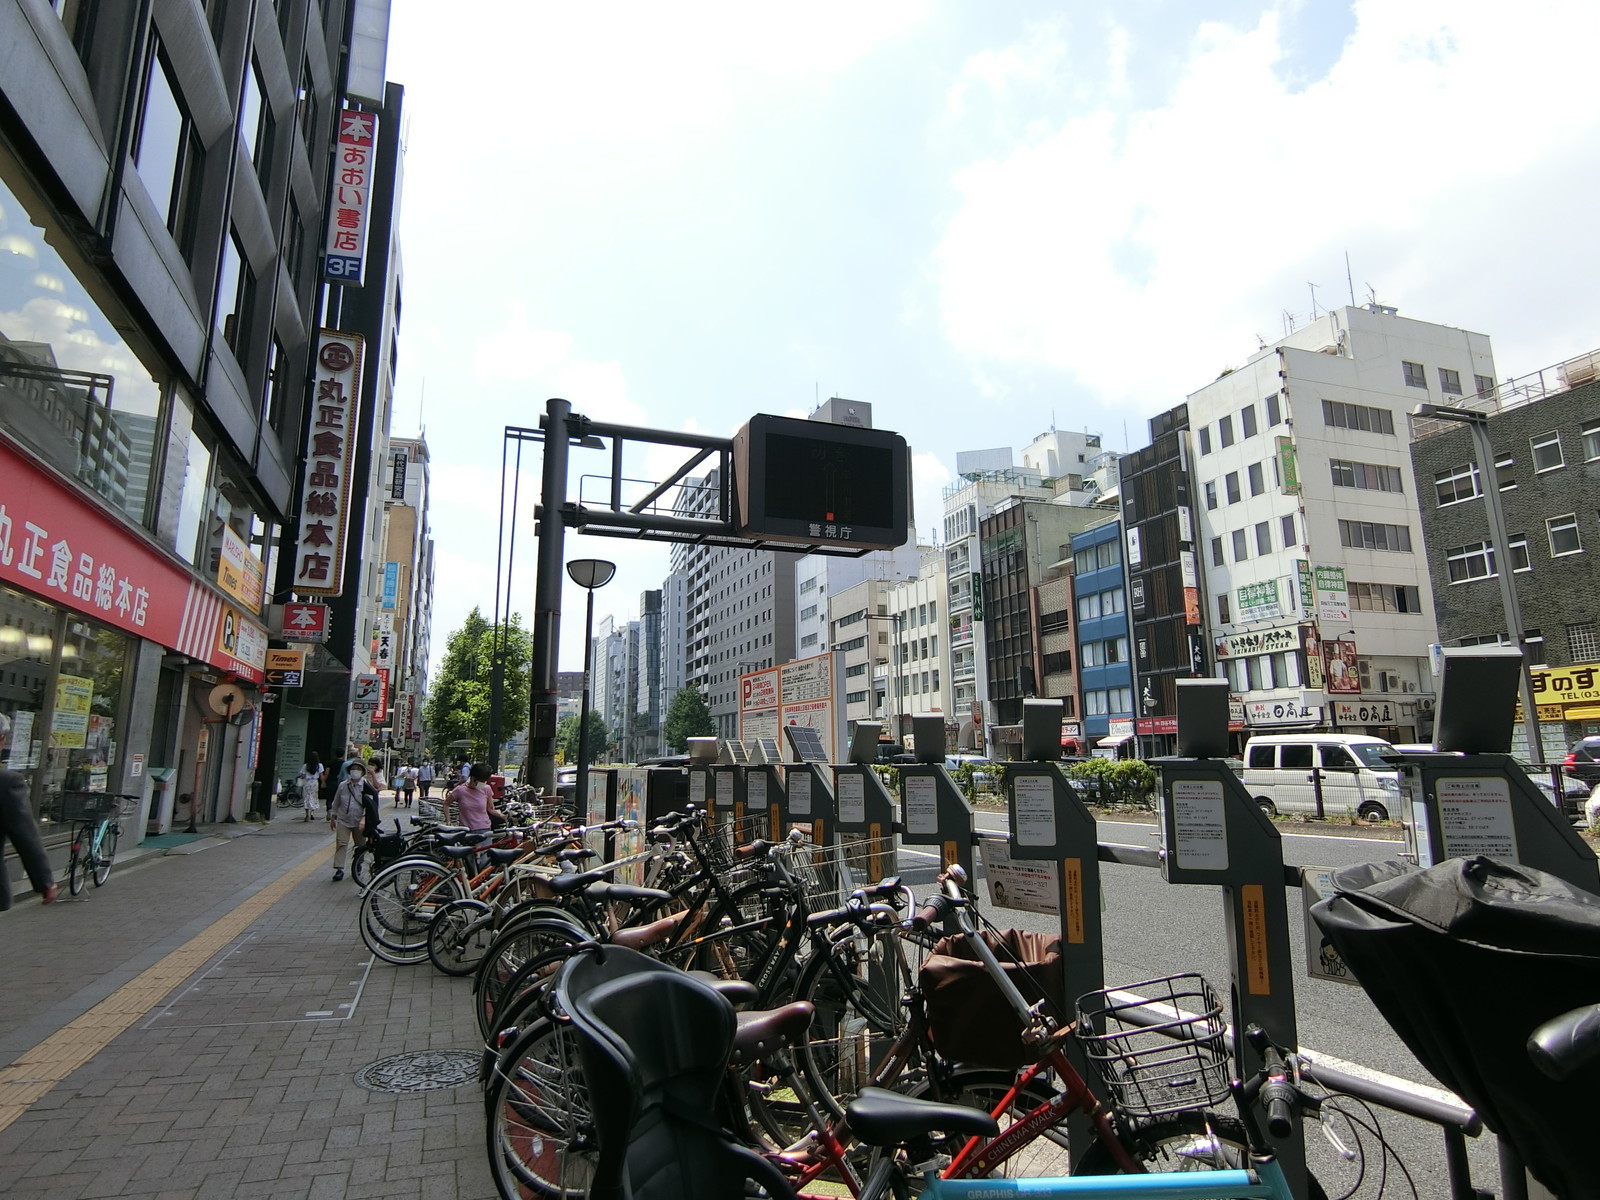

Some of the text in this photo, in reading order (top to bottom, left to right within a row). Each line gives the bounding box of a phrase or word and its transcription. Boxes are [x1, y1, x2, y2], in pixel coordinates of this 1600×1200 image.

[341, 115, 373, 142] 本
[333, 147, 366, 251] あおい書店
[327, 258, 360, 276] 3F
[299, 377, 347, 580] 丸正食品総本店
[808, 523, 852, 540] 警視庁
[290, 606, 317, 629] 本
[1304, 609, 1314, 619] 3F
[1230, 629, 1293, 649] いきなり ステーキ
[271, 654, 299, 663] Times
[283, 671, 300, 685] 空
[743, 680, 752, 708] P
[1273, 701, 1313, 719] 日高屋
[1359, 704, 1393, 723] 日高屋
[987, 1108, 1057, 1161] CHINEMA WALK
[967, 1188, 1014, 1200] GRAPHIS
